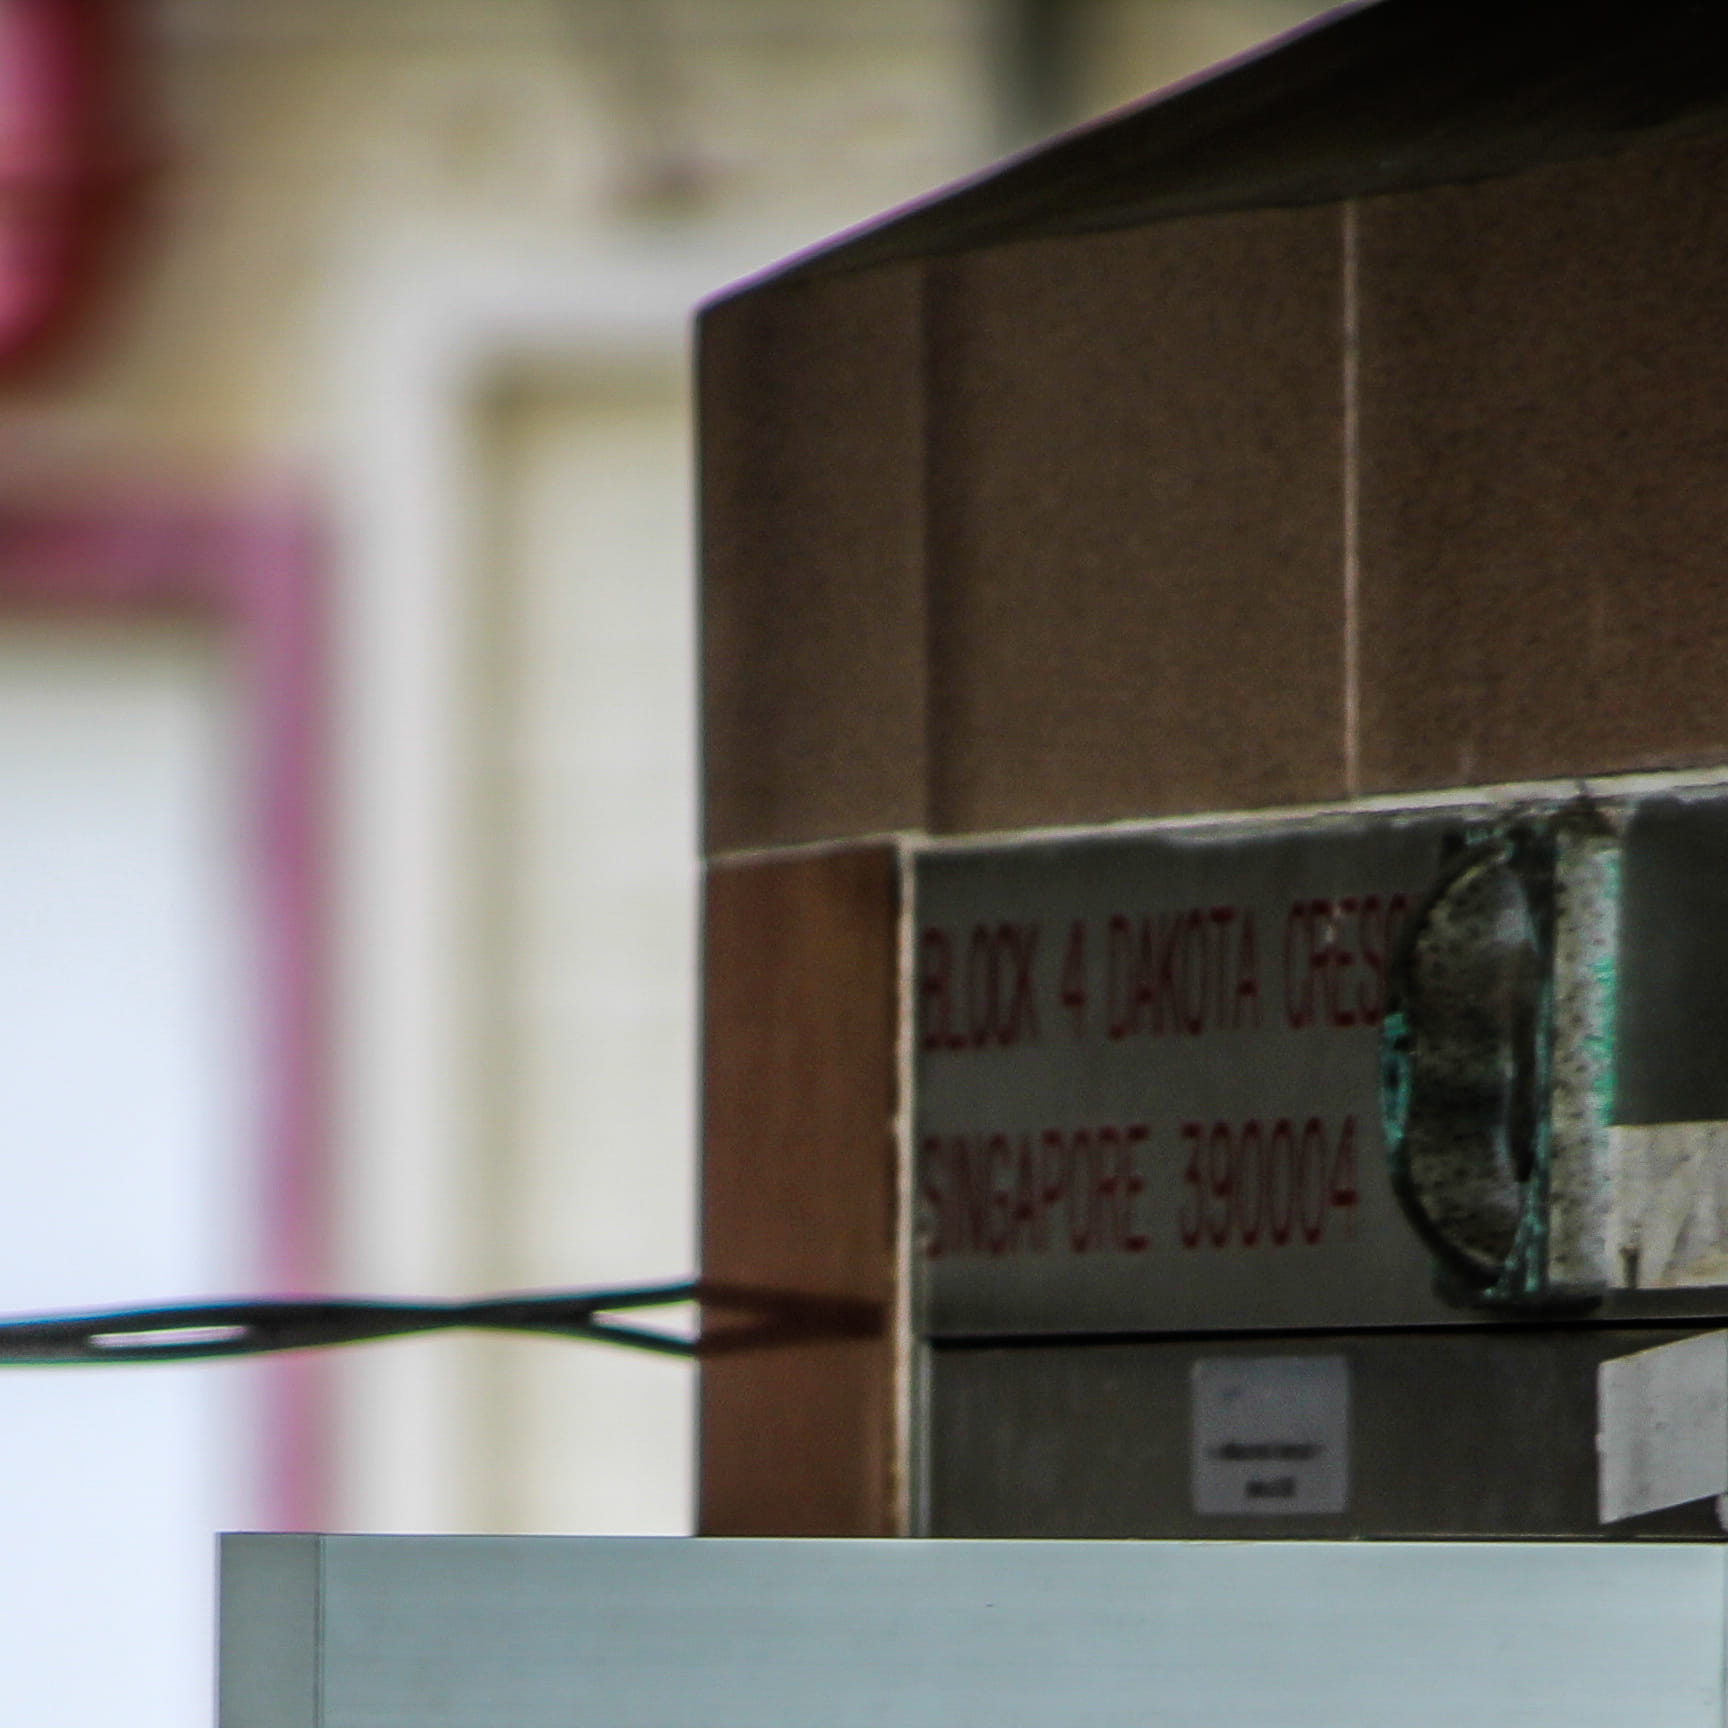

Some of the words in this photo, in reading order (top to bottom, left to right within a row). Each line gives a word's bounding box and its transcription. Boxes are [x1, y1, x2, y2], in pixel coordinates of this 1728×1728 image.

[921, 921, 1043, 1051] BLOCK
[1060, 918, 1087, 1040] 4
[1107, 906, 1262, 1040] DAKOTA
[921, 1124, 1152, 1260] SINGAPORE
[1178, 1113, 1359, 1251] 390004
